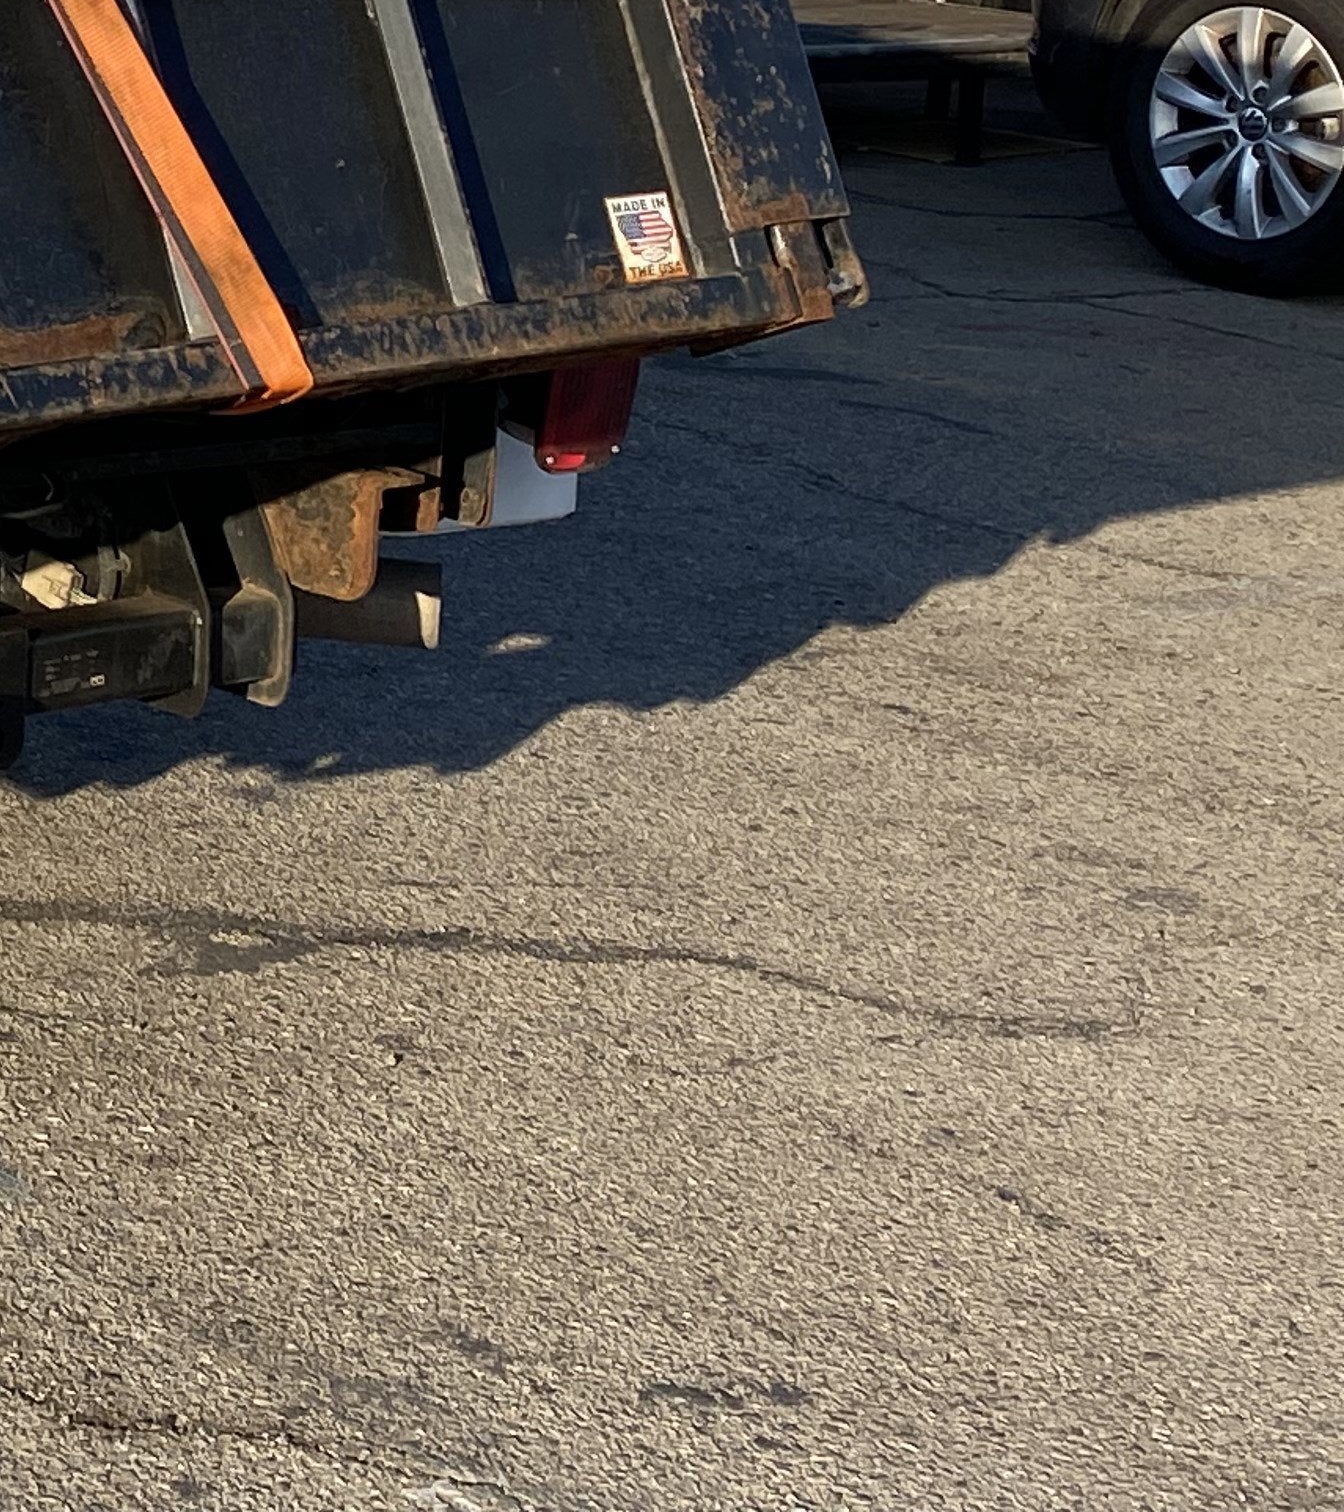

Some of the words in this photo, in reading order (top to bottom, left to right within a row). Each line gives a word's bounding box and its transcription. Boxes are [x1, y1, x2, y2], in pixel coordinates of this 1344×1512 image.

[611, 199, 649, 213] MADE
[651, 197, 665, 208] IN
[629, 264, 656, 279] THE
[658, 260, 683, 276] USA
